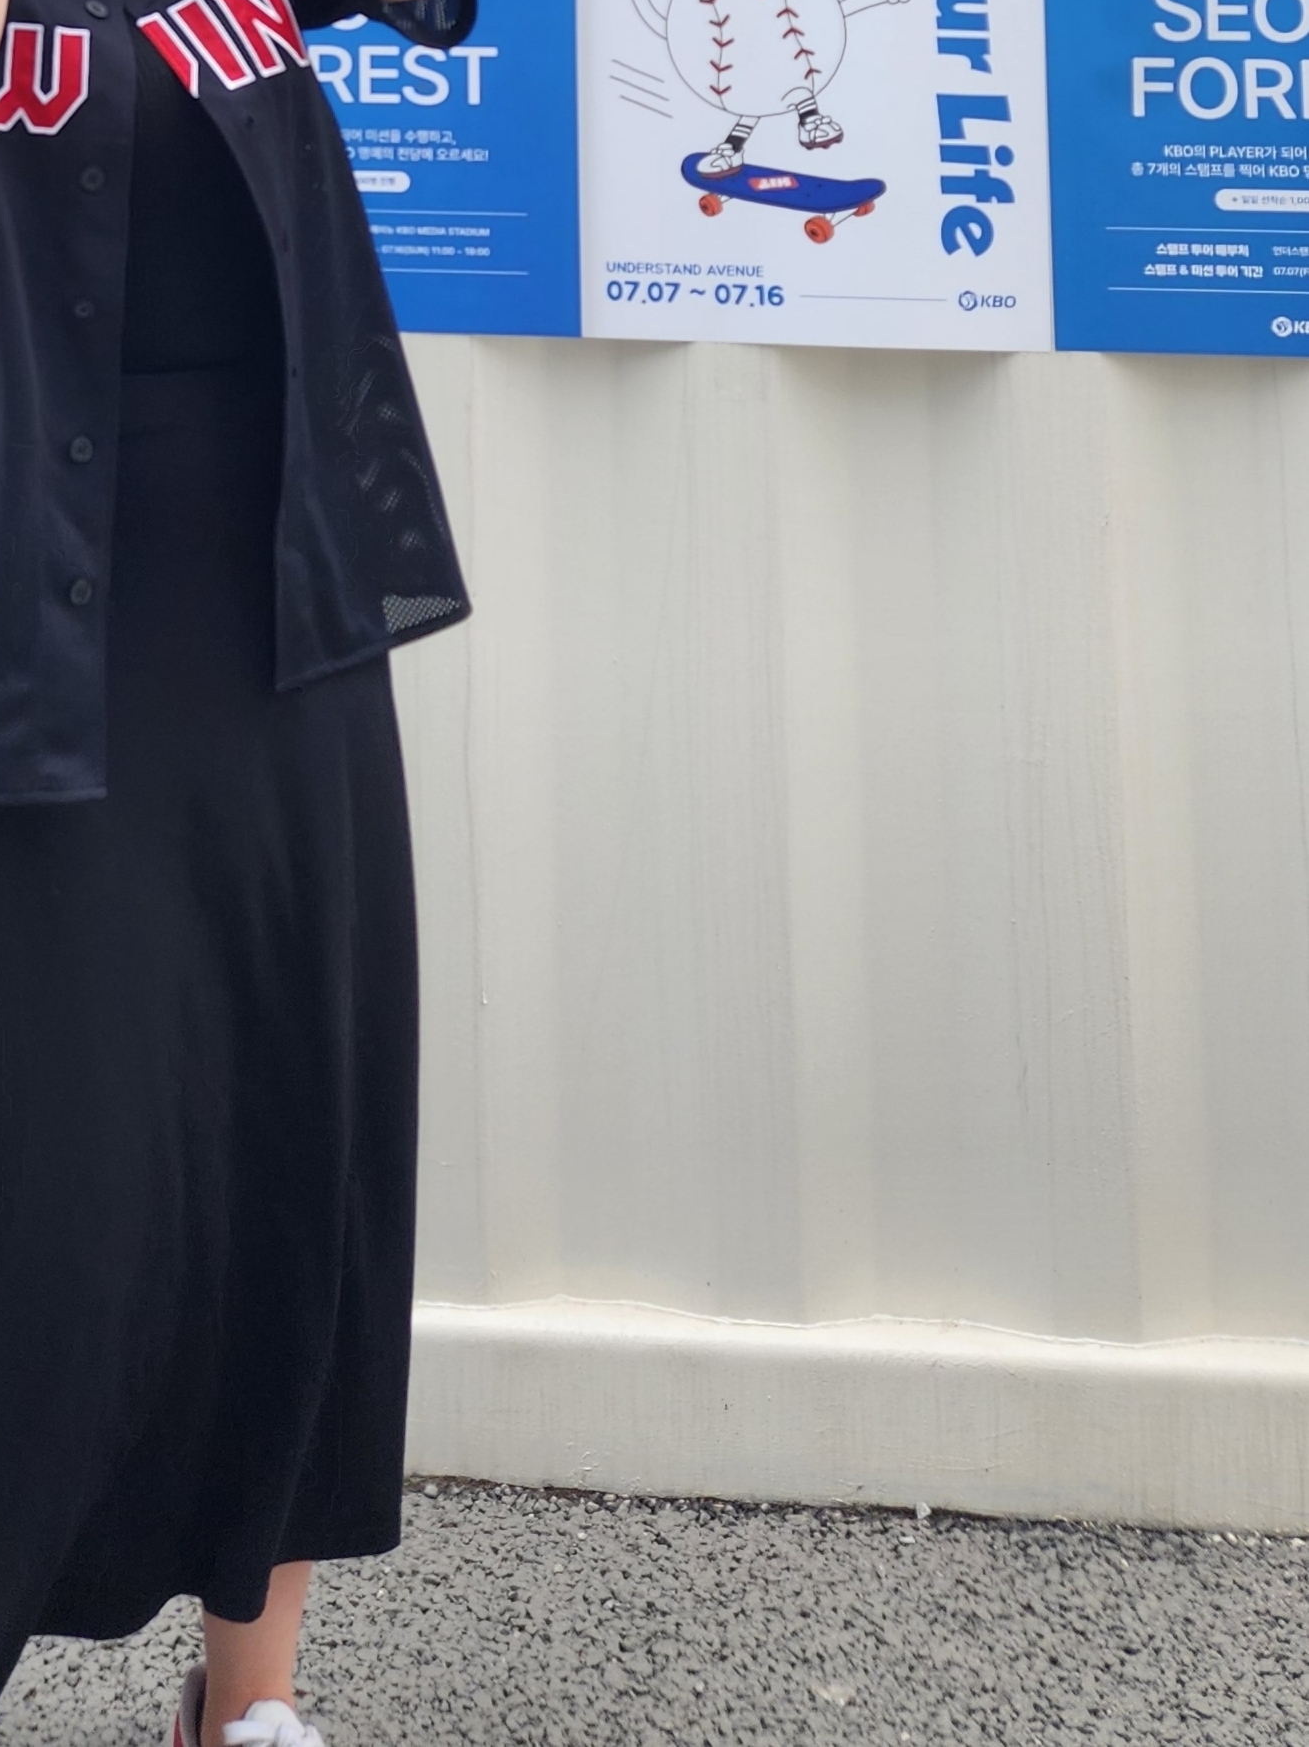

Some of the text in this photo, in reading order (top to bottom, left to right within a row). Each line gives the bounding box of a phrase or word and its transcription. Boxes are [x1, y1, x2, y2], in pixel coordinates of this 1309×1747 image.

[308, 44, 498, 105] REST
[1132, 57, 1309, 120] FOR
[1164, 145, 1205, 158] KBO의
[1209, 146, 1277, 159] PLAYER가
[936, 94, 1014, 256] Life
[1147, 163, 1181, 176] 7개의
[1185, 163, 1235, 177] 스탬프를
[1239, 164, 1265, 177] 찍어
[1269, 165, 1299, 177] KBO
[607, 262, 764, 277] UNDERSTAND AVENUE
[607, 281, 680, 303] 07.07
[715, 284, 784, 307] 07.16
[981, 295, 1016, 308] KBO
